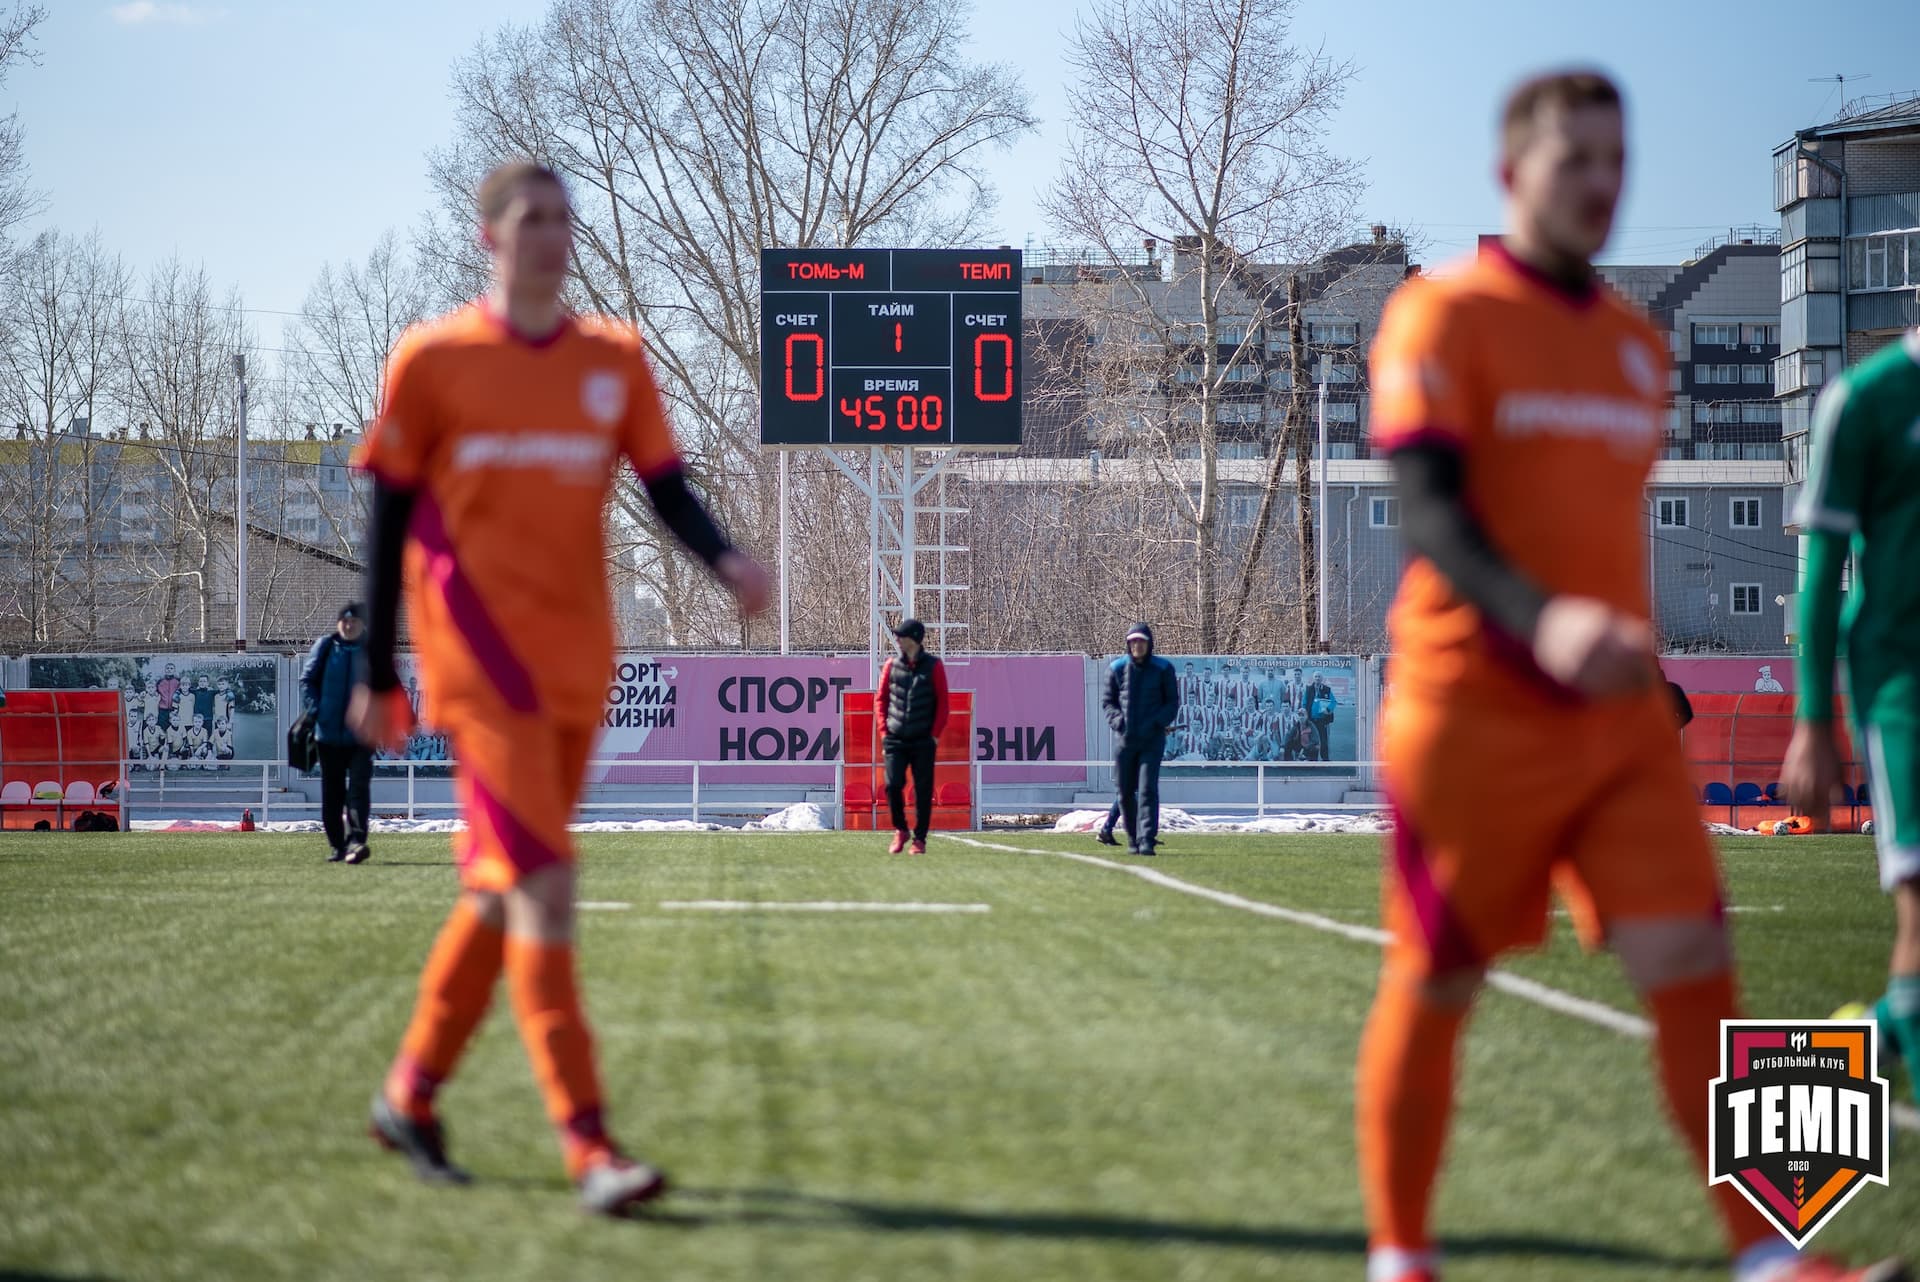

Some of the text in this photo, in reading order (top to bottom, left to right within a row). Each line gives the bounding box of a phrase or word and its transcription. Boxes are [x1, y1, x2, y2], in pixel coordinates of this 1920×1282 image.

[787, 262, 865, 280] ТОМЬ-М
[959, 262, 1012, 280] ТЕМП
[868, 302, 914, 316] ТАЙМ
[775, 314, 818, 326] СЧЕТ
[964, 314, 1007, 326] СЧЕТ
[895, 322, 902, 353] 1
[785, 333, 824, 401] 0
[974, 333, 1013, 401] 0
[864, 379, 919, 391] ВРЕМЯ
[1227, 659, 1242, 667] ФК
[611, 663, 662, 682] ОРТ
[606, 685, 677, 705] ОРМА
[718, 676, 852, 713] СПОРТ
[719, 726, 1056, 761] НОРМ ЗНИ
